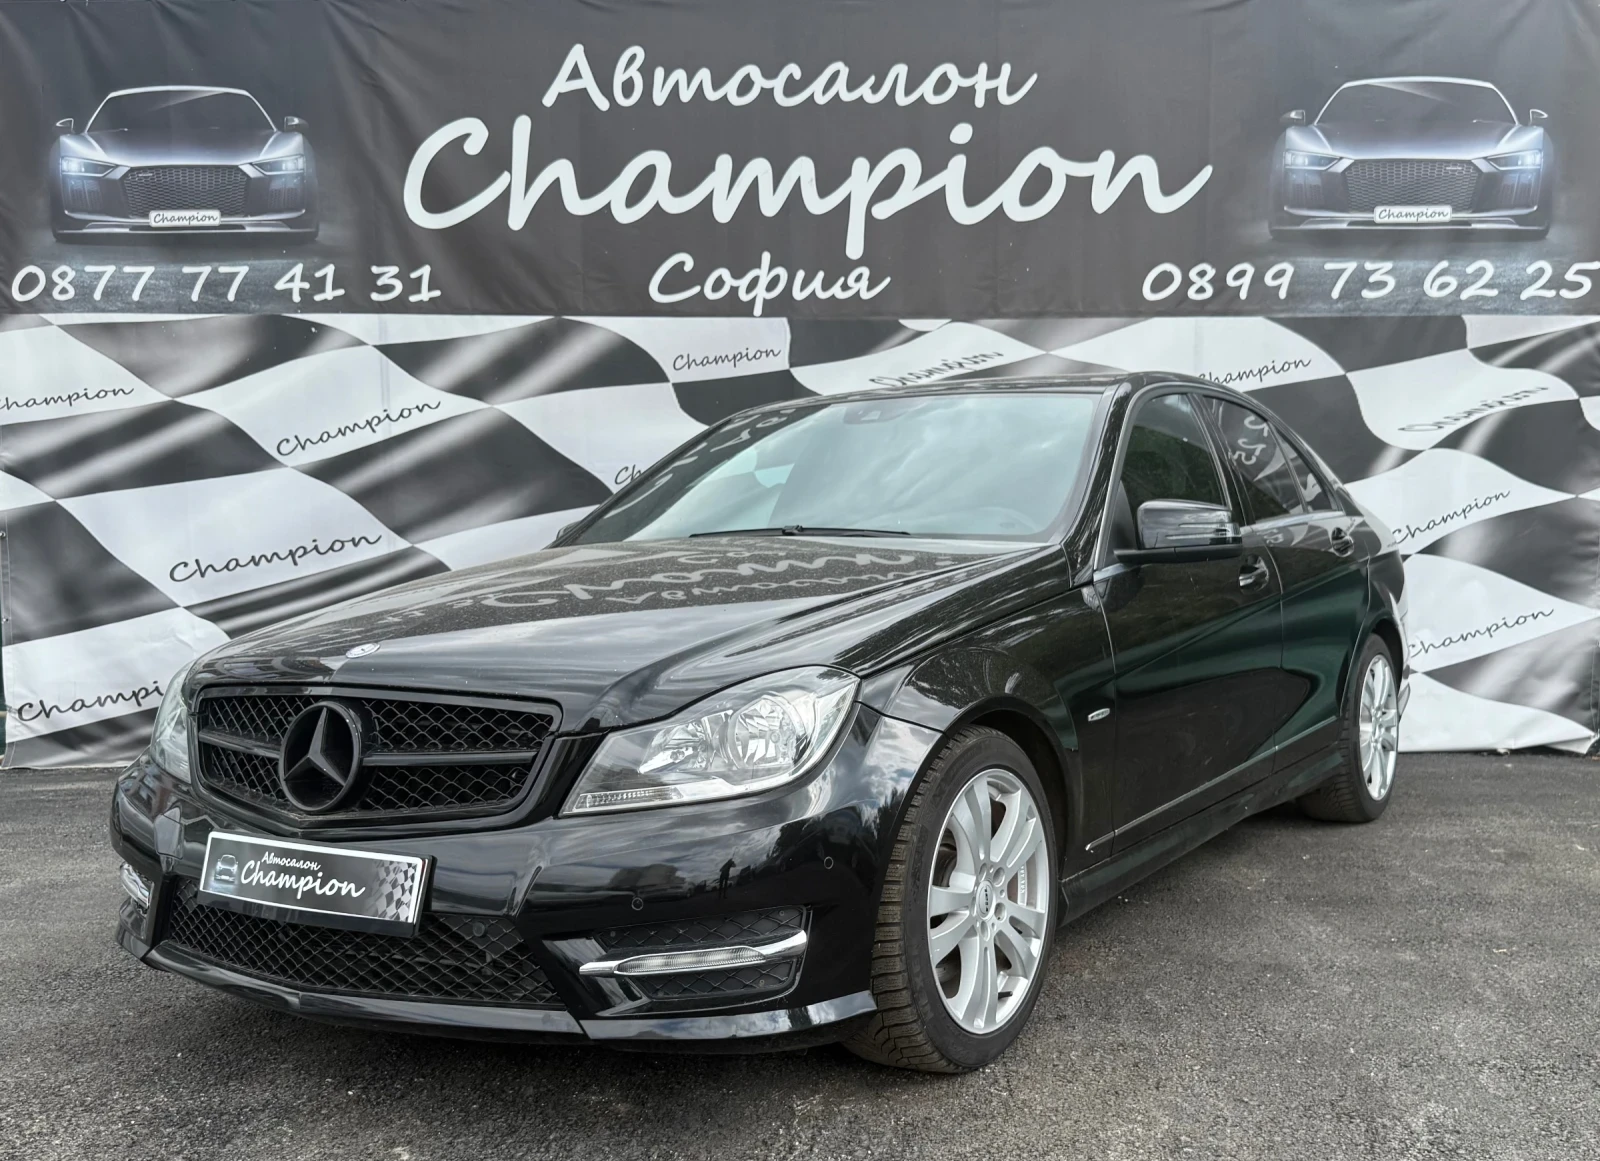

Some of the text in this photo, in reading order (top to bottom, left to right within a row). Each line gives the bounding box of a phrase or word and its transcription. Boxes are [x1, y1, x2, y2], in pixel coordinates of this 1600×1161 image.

[542, 44, 1038, 112] Автосалон
[404, 115, 1213, 260] Champion
[153, 212, 218, 226] Champion
[1378, 207, 1450, 222] Champion
[12, 263, 441, 303] 0877 77 41 31
[649, 252, 891, 317] София
[1142, 260, 1600, 301] 0899 73 62 25
[673, 347, 782, 371] Champion
[1199, 358, 1312, 384] hampion
[0, 387, 134, 411] hampion
[276, 400, 441, 457] Champion
[169, 533, 382, 583] Champion
[240, 860, 366, 899] Champion
[262, 851, 321, 871] Автосалон
